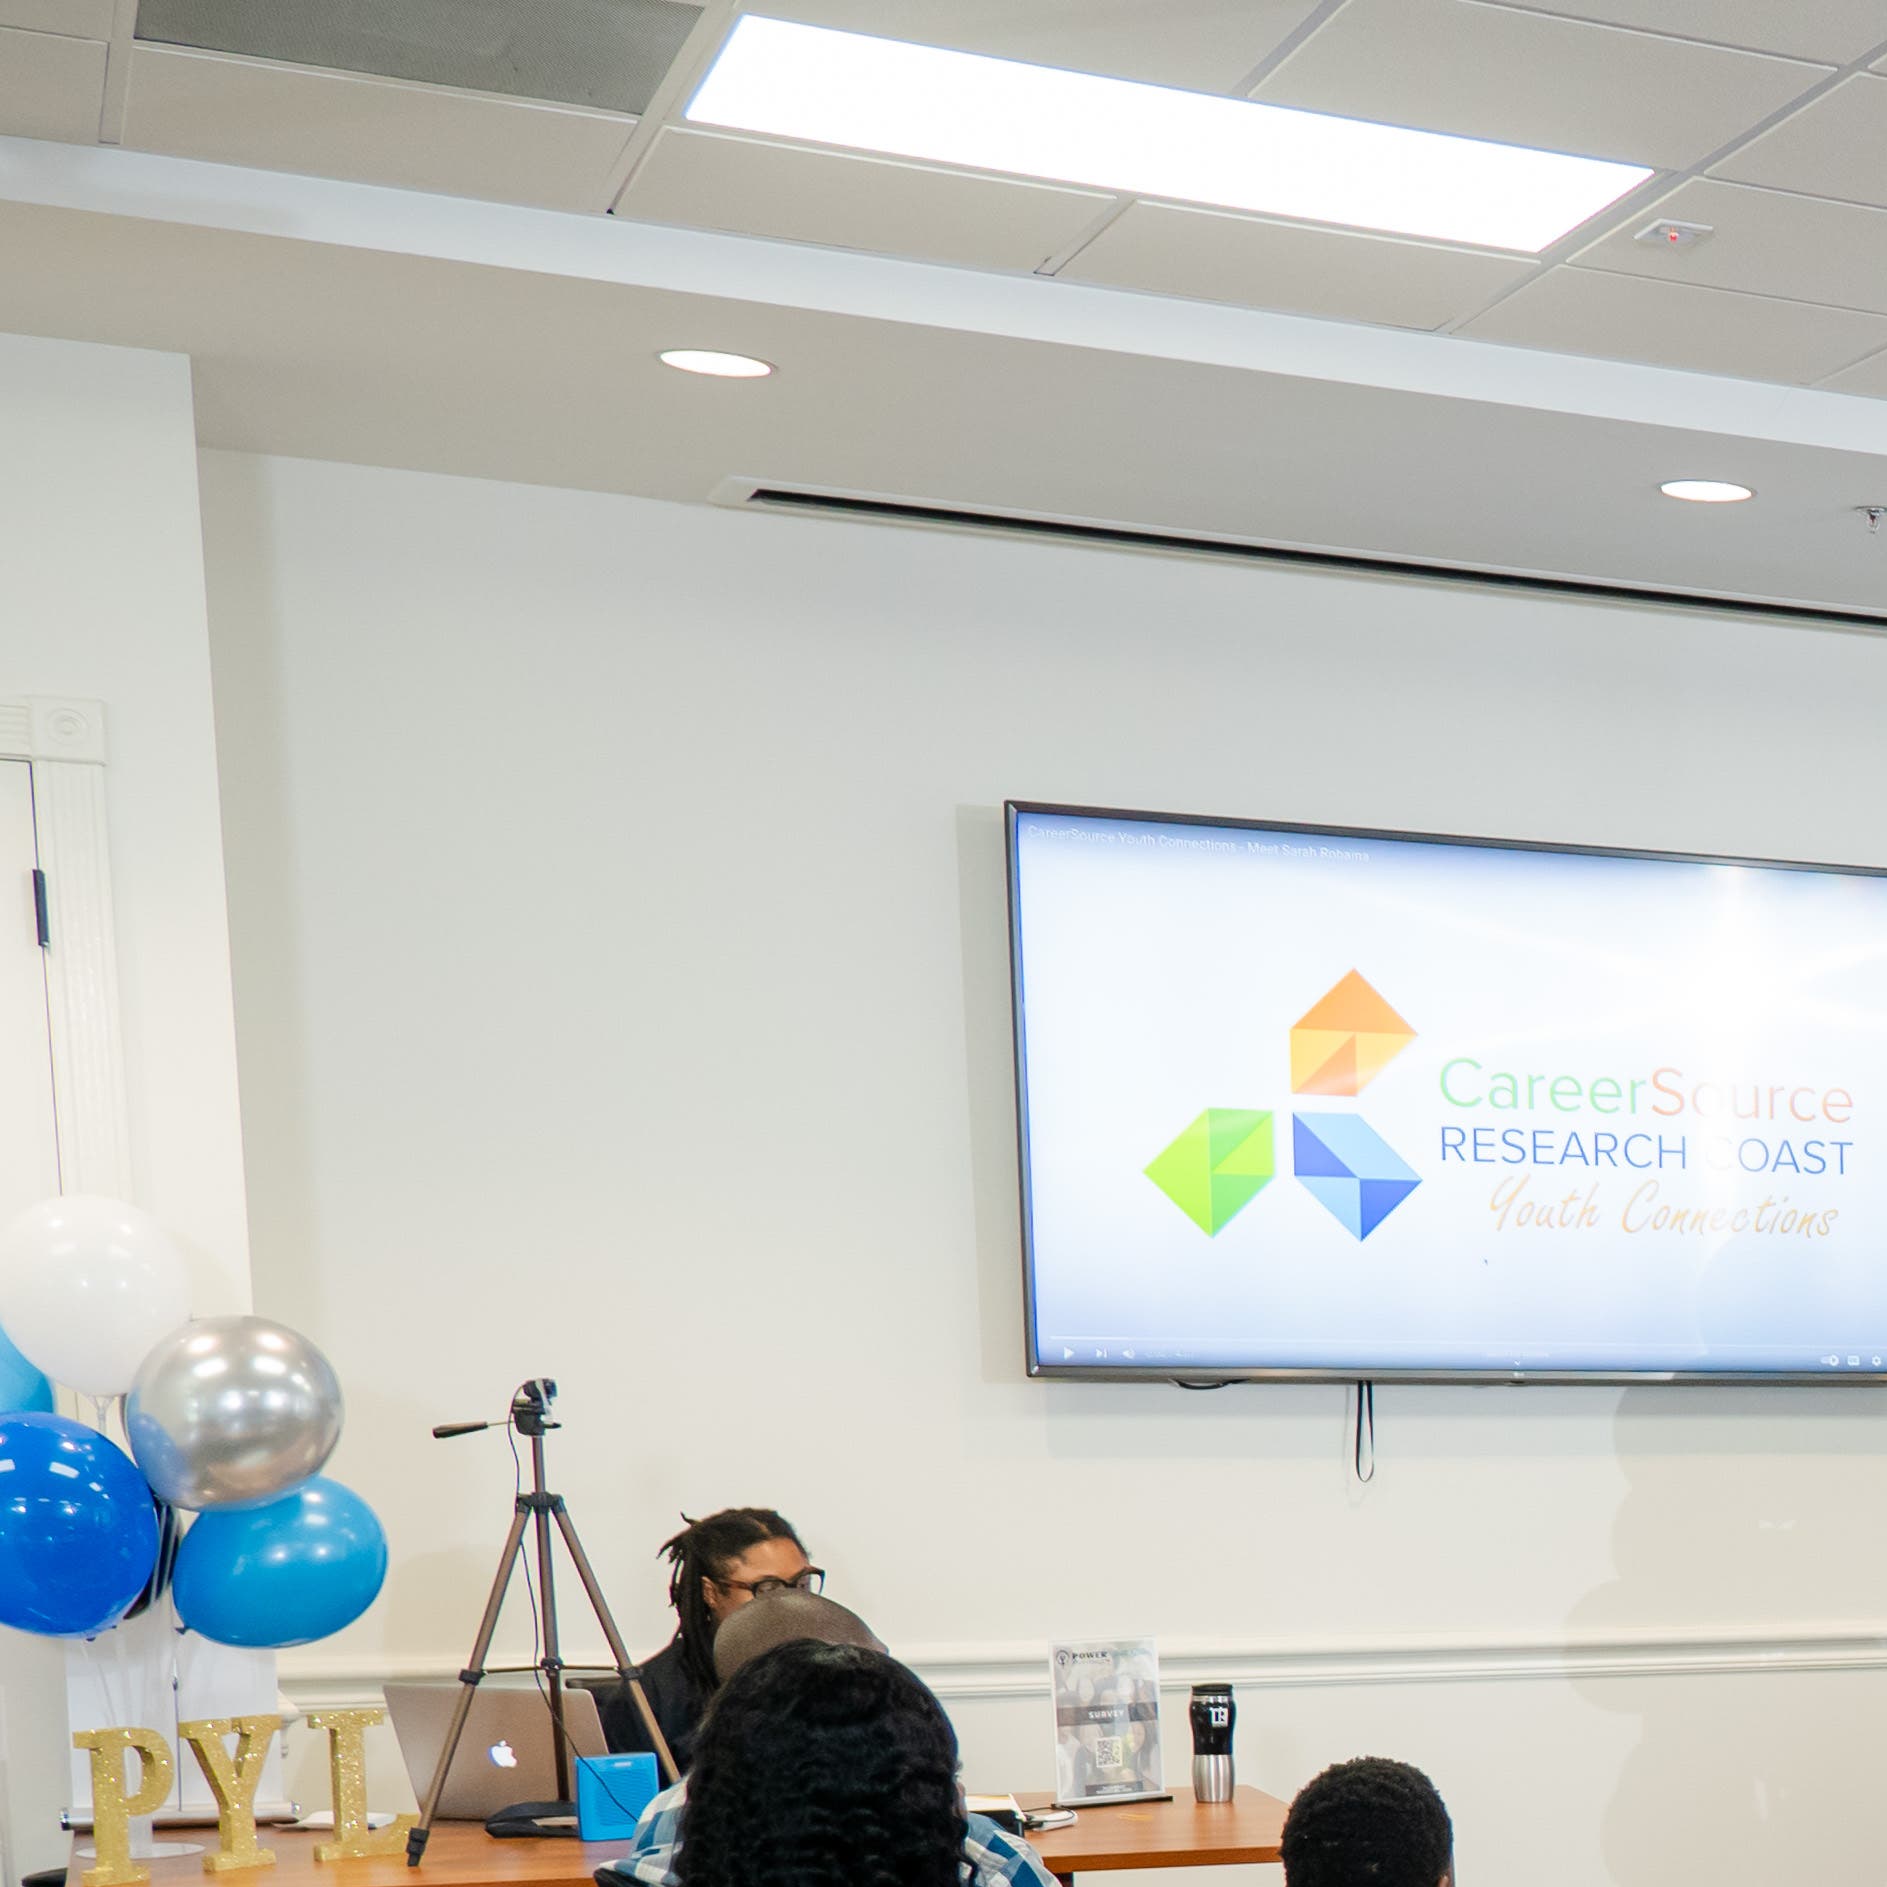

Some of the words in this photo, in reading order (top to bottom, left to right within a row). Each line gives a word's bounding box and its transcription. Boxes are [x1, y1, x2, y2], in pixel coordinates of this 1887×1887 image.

[1028, 824, 1114, 844] CareerSource
[1118, 831, 1156, 848] Youth
[1159, 833, 1237, 854] Connections
[1248, 841, 1279, 857] Meet
[1282, 843, 1317, 860] Sarah
[1439, 1057, 1854, 1123] CareerSource
[1441, 1126, 1688, 1170] RESEARCH
[1486, 1174, 1601, 1234] Youth
[1622, 1181, 1839, 1239] Connections
[1072, 1650, 1108, 1660] POWER
[1088, 1709, 1124, 1719] SURVEY
